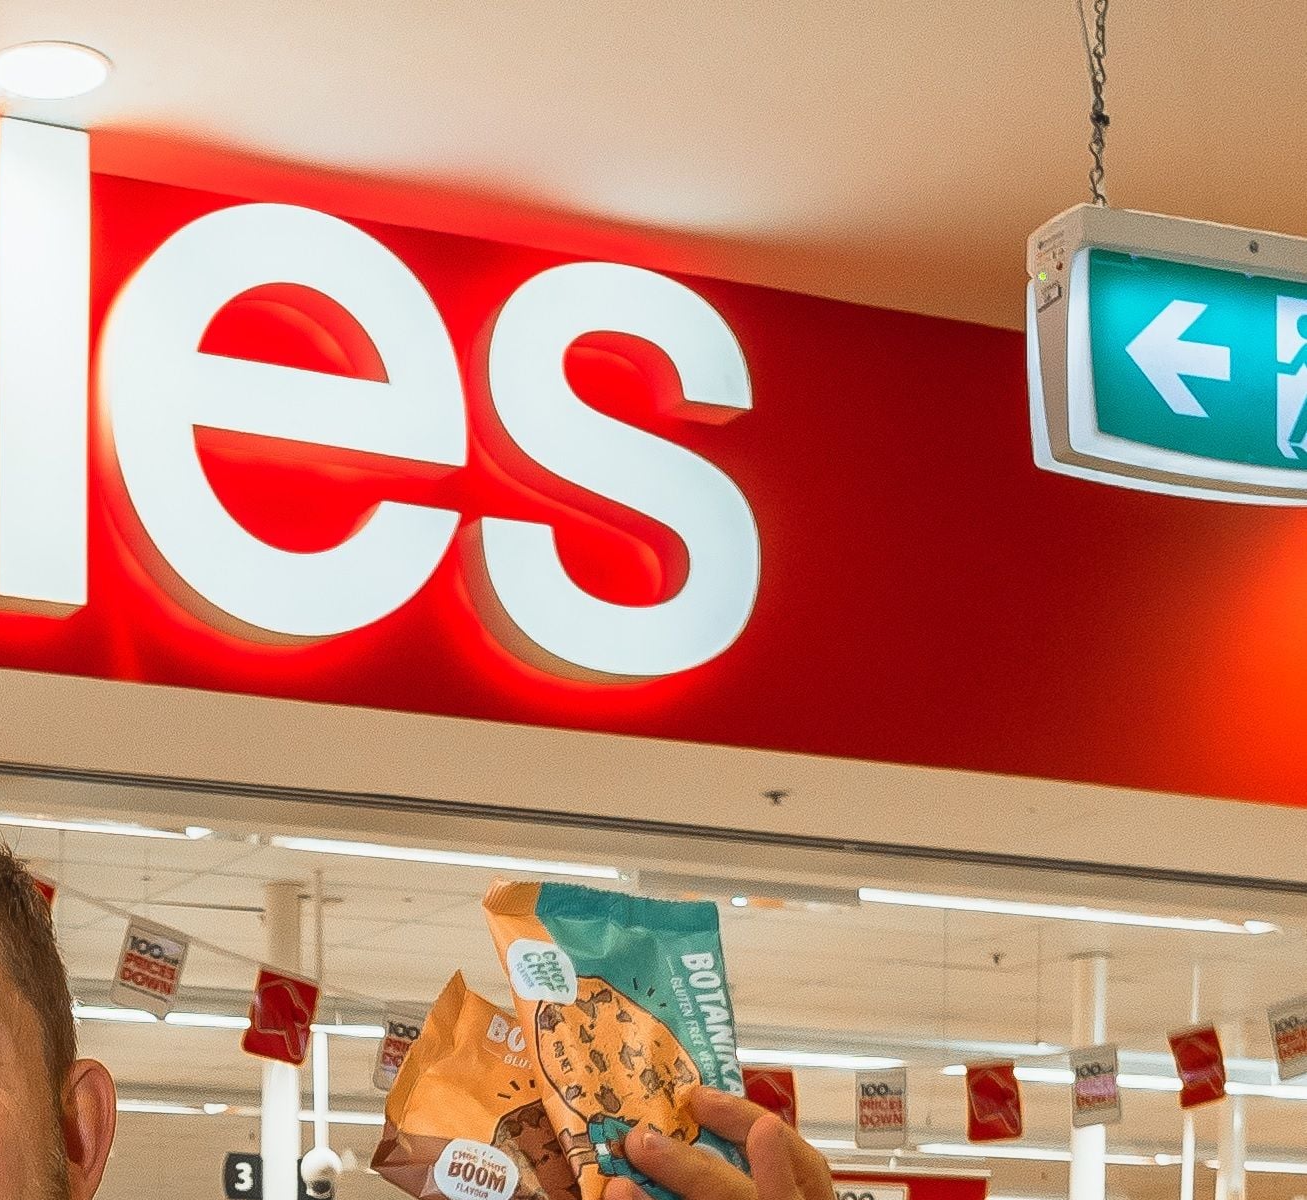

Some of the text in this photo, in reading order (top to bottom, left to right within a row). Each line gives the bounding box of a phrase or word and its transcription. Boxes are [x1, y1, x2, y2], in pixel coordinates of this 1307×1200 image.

[130, 935, 164, 959] 100
[122, 968, 173, 995] DOWN
[670, 976, 695, 1017] GLUTEN
[686, 1018, 708, 1048] FREE
[388, 1020, 421, 1041] 100
[680, 951, 746, 1099] BOTANIKA
[860, 1082, 889, 1096] 100
[859, 1114, 903, 1128] DOWN
[234, 1162, 254, 1191] 3
[447, 1161, 507, 1194] BOOM
[455, 1182, 489, 1200] FLAVOUR
